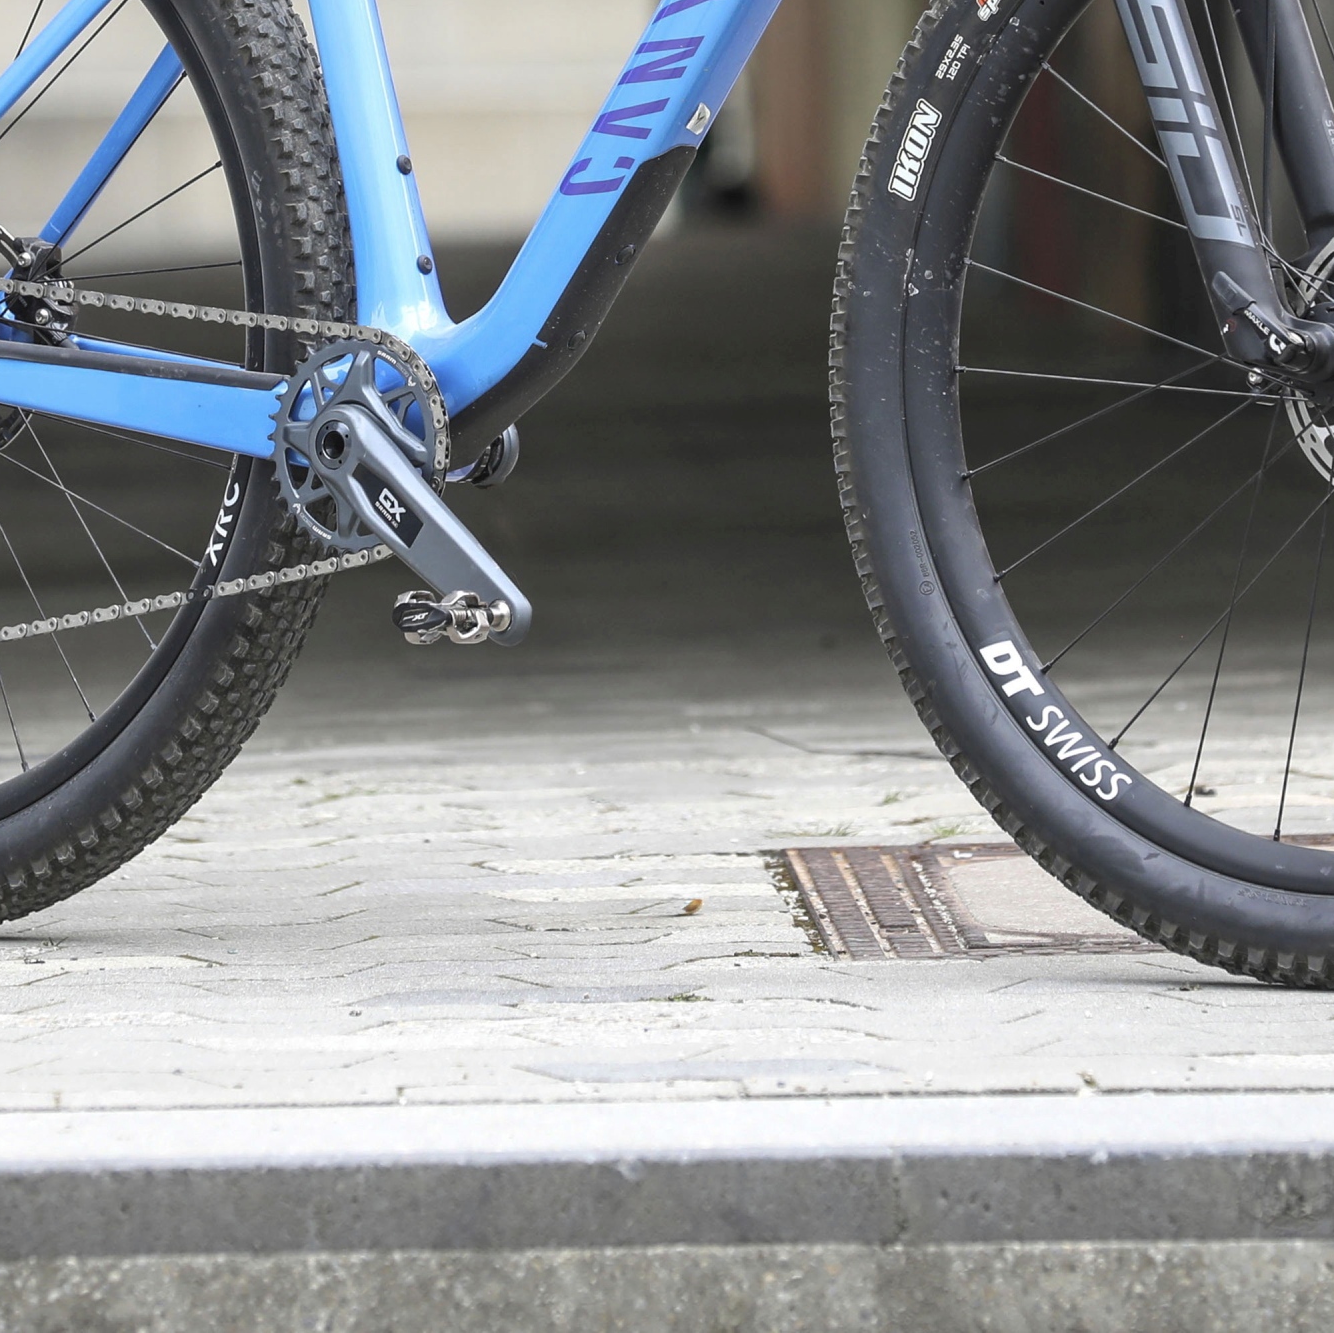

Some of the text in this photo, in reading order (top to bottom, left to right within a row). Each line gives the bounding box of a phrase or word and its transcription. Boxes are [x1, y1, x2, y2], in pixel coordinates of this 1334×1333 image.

[934, 34, 964, 80] 29X2.35
[946, 44, 971, 81] 120 TPI
[889, 99, 941, 200] IKON
[1230, 203, 1247, 237] SL
[1244, 309, 1270, 336] MAXLE
[377, 350, 397, 365] SRAM
[374, 500, 393, 521] SRAM
[378, 487, 407, 523] GX
[205, 482, 240, 567] XRC
[979, 640, 1133, 801] DT SWISS
